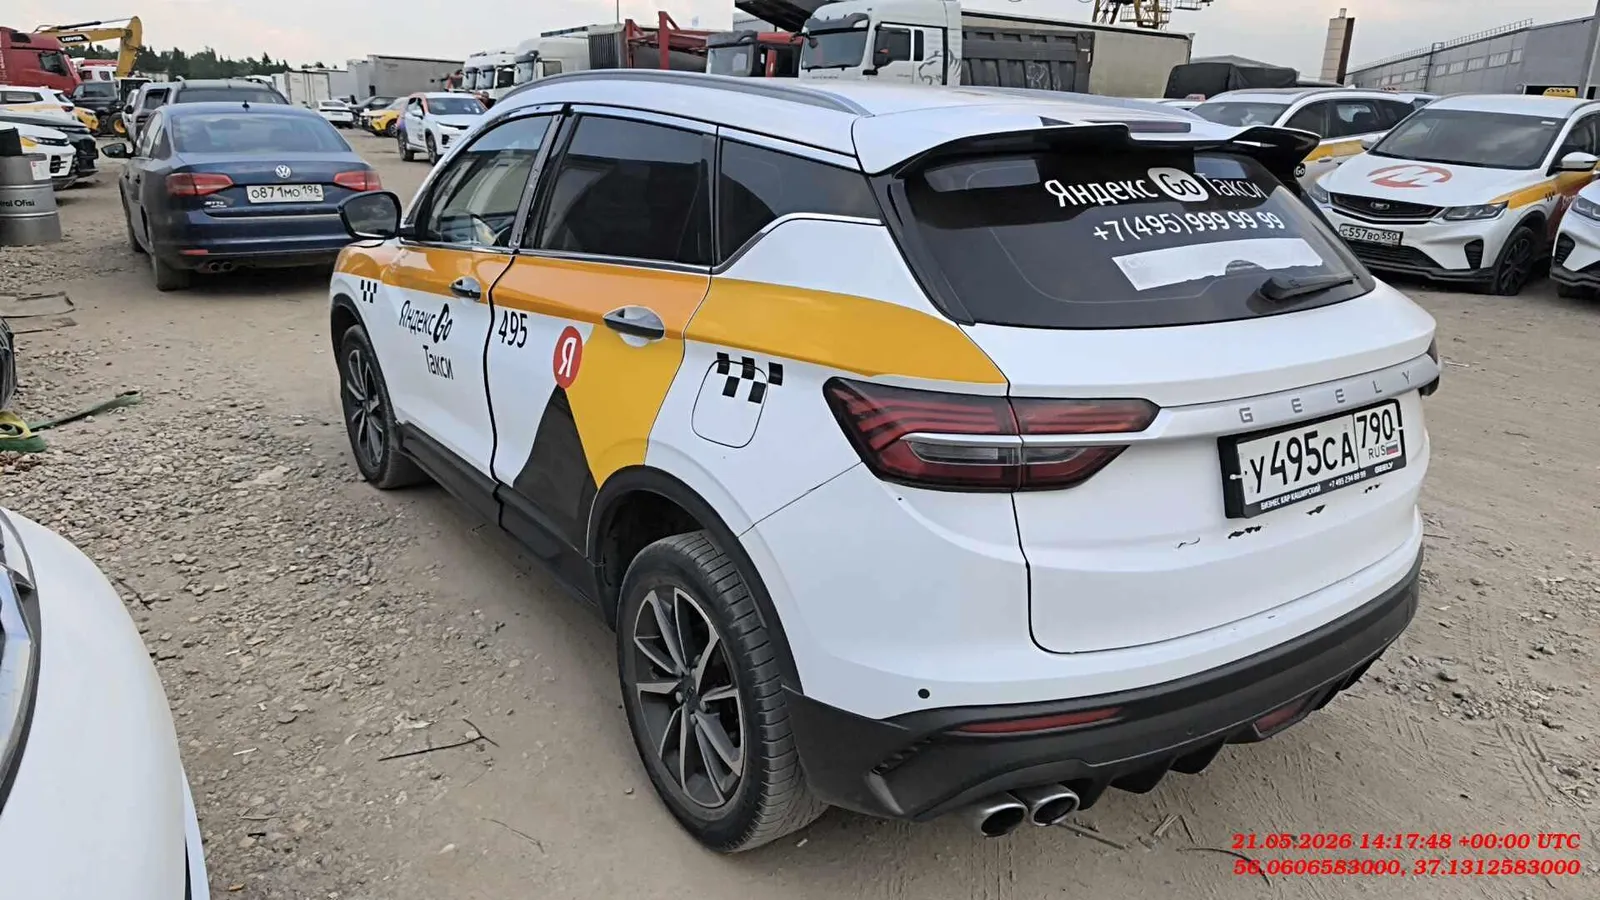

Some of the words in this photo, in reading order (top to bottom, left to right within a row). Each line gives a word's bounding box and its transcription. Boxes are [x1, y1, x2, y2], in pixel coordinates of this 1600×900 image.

[302, 185, 320, 194] 196
[1045, 179, 1158, 208] Яндекс
[1157, 172, 1201, 197] Go
[1194, 172, 1269, 199] Такси
[1227, 211, 1258, 230] 99
[1256, 211, 1285, 230] 99
[1341, 227, 1380, 241] С557ВО
[1381, 231, 1397, 241] 550
[399, 300, 436, 335] Яндекс
[433, 303, 453, 343] Go
[498, 310, 528, 348] 495
[423, 344, 454, 380] Такси
[558, 337, 577, 378] Я
[1239, 370, 1412, 424] GEELY
[1249, 430, 1356, 494] У495СА
[1356, 408, 1393, 449] 790
[1368, 445, 1386, 460] RUS
[1374, 461, 1394, 474] GEELY
